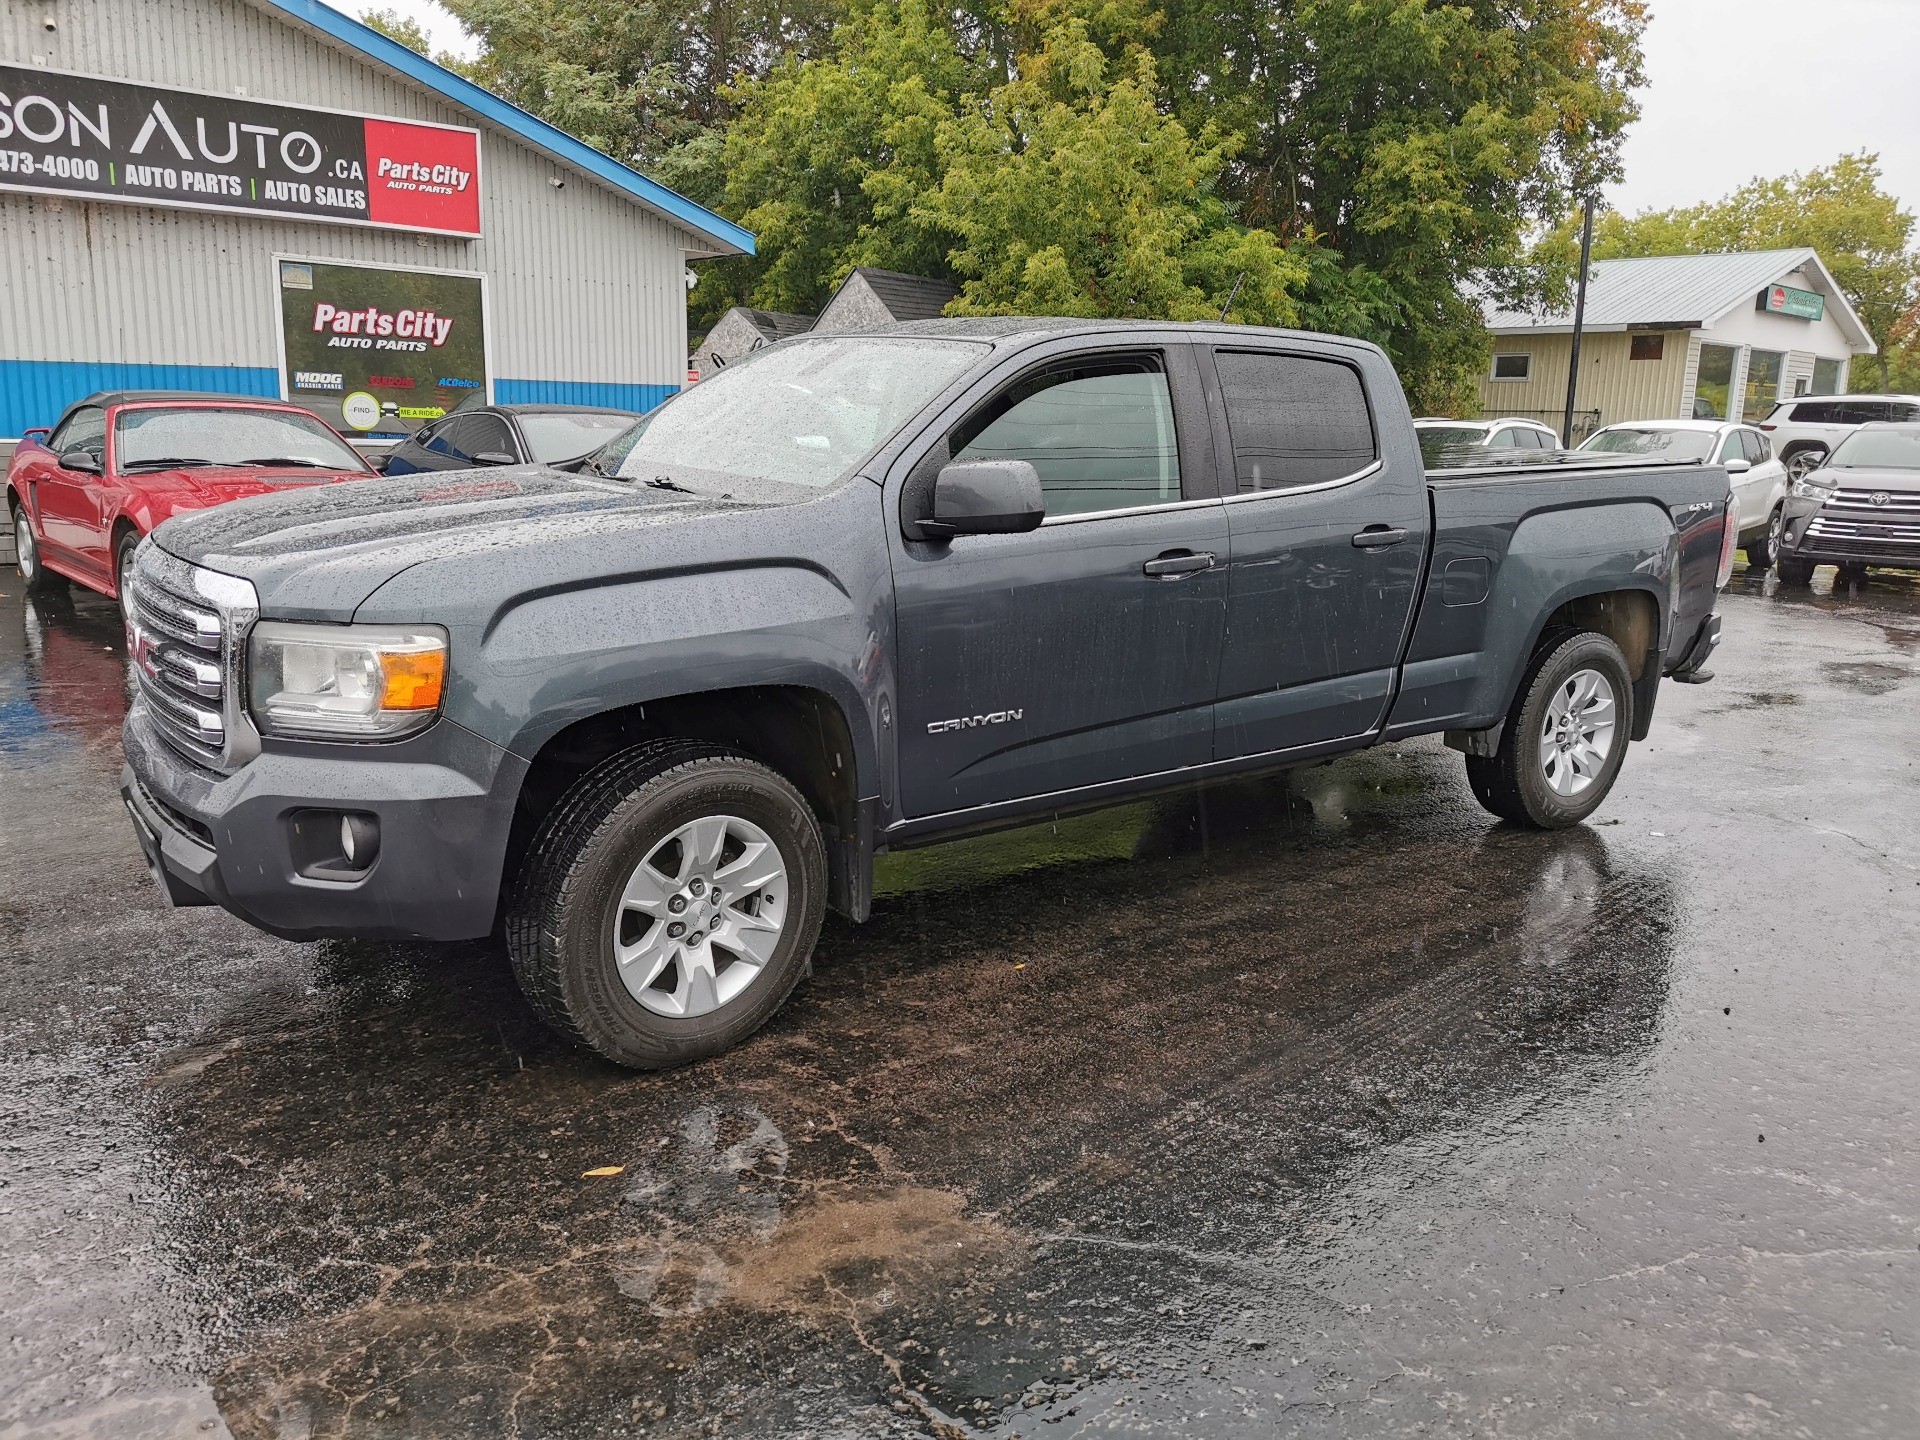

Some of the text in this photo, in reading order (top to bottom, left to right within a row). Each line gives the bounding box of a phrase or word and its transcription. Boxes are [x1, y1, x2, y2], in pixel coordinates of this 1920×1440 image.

[130, 100, 322, 174] AUTO
[0, 149, 366, 210] 473-4000 AUTO PARTS AUTO SALES
[387, 181, 453, 195] AUTO PARTS
[327, 337, 427, 351] AUTO PARTS
[295, 371, 343, 384] MOOG
[353, 406, 370, 414] FIND
[927, 708, 1024, 735] CANYON
